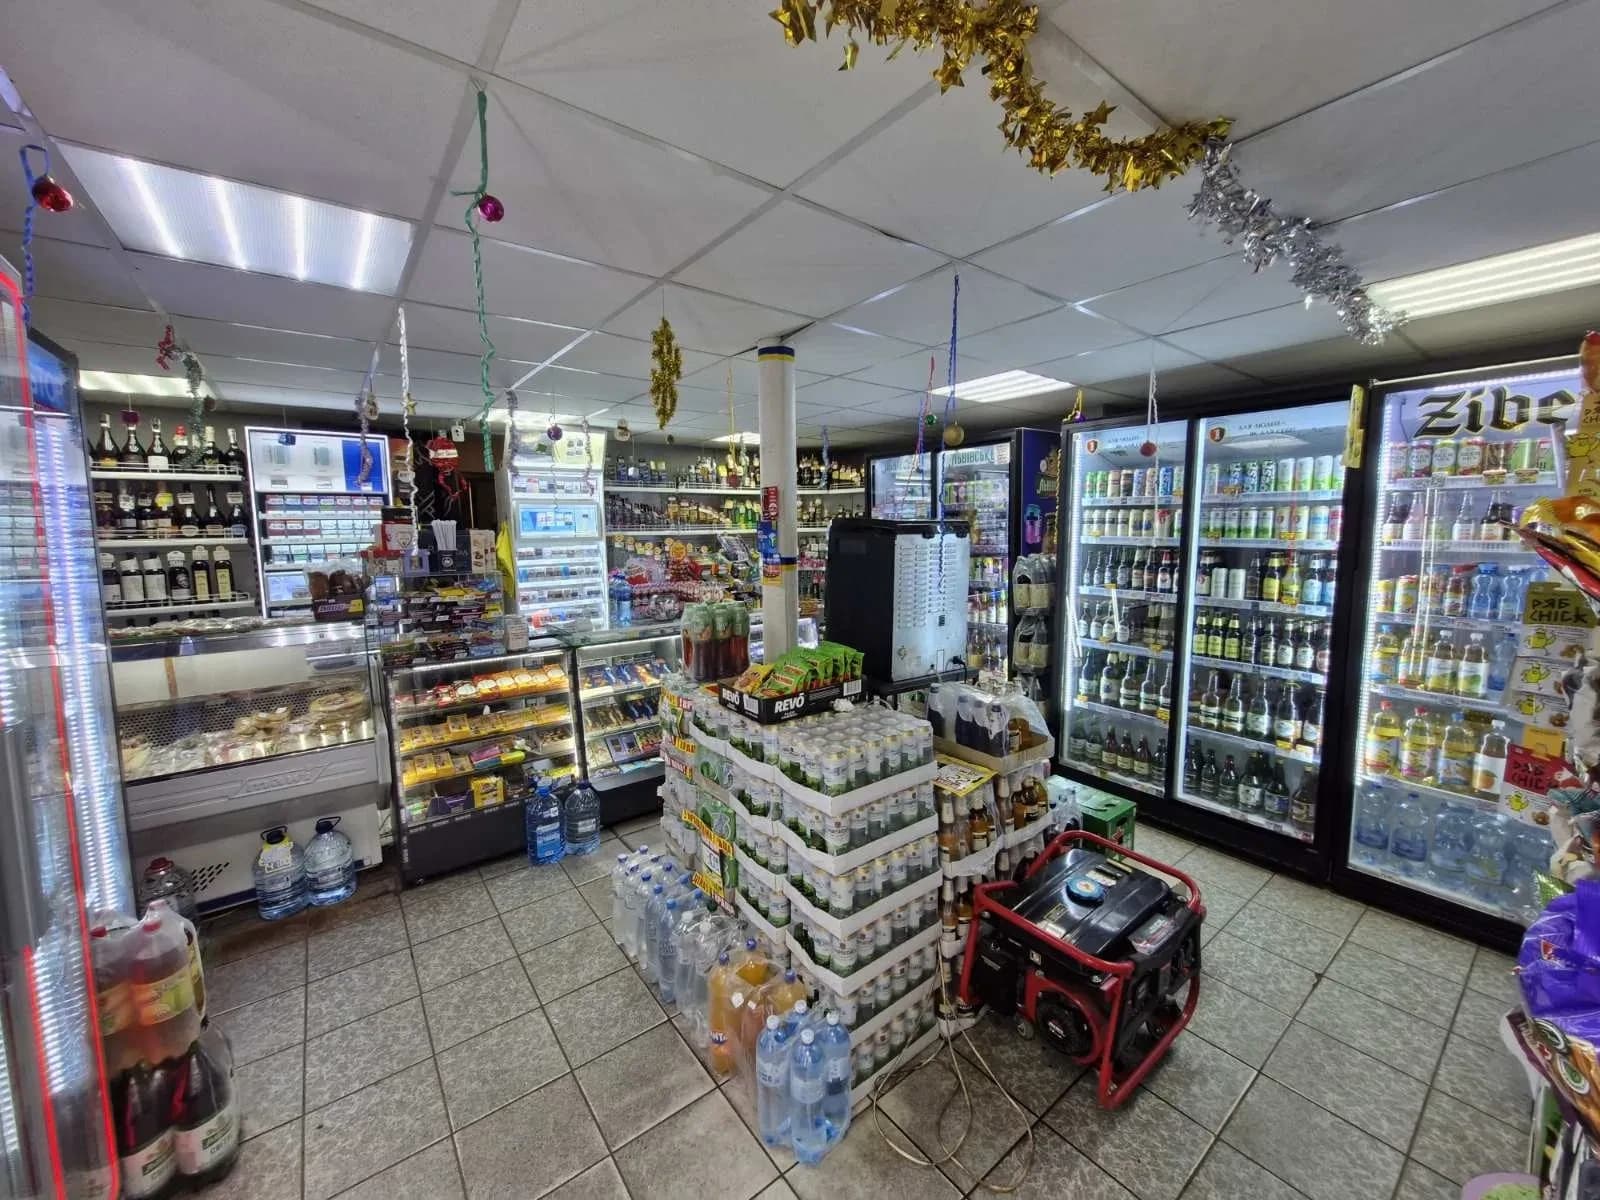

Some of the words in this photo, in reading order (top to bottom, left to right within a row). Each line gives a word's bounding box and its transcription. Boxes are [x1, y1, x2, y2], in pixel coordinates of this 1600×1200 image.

[1413, 385, 1577, 438] Zibe
[1529, 607, 1588, 624] CHICK
[1512, 773, 1546, 790] CHIC
